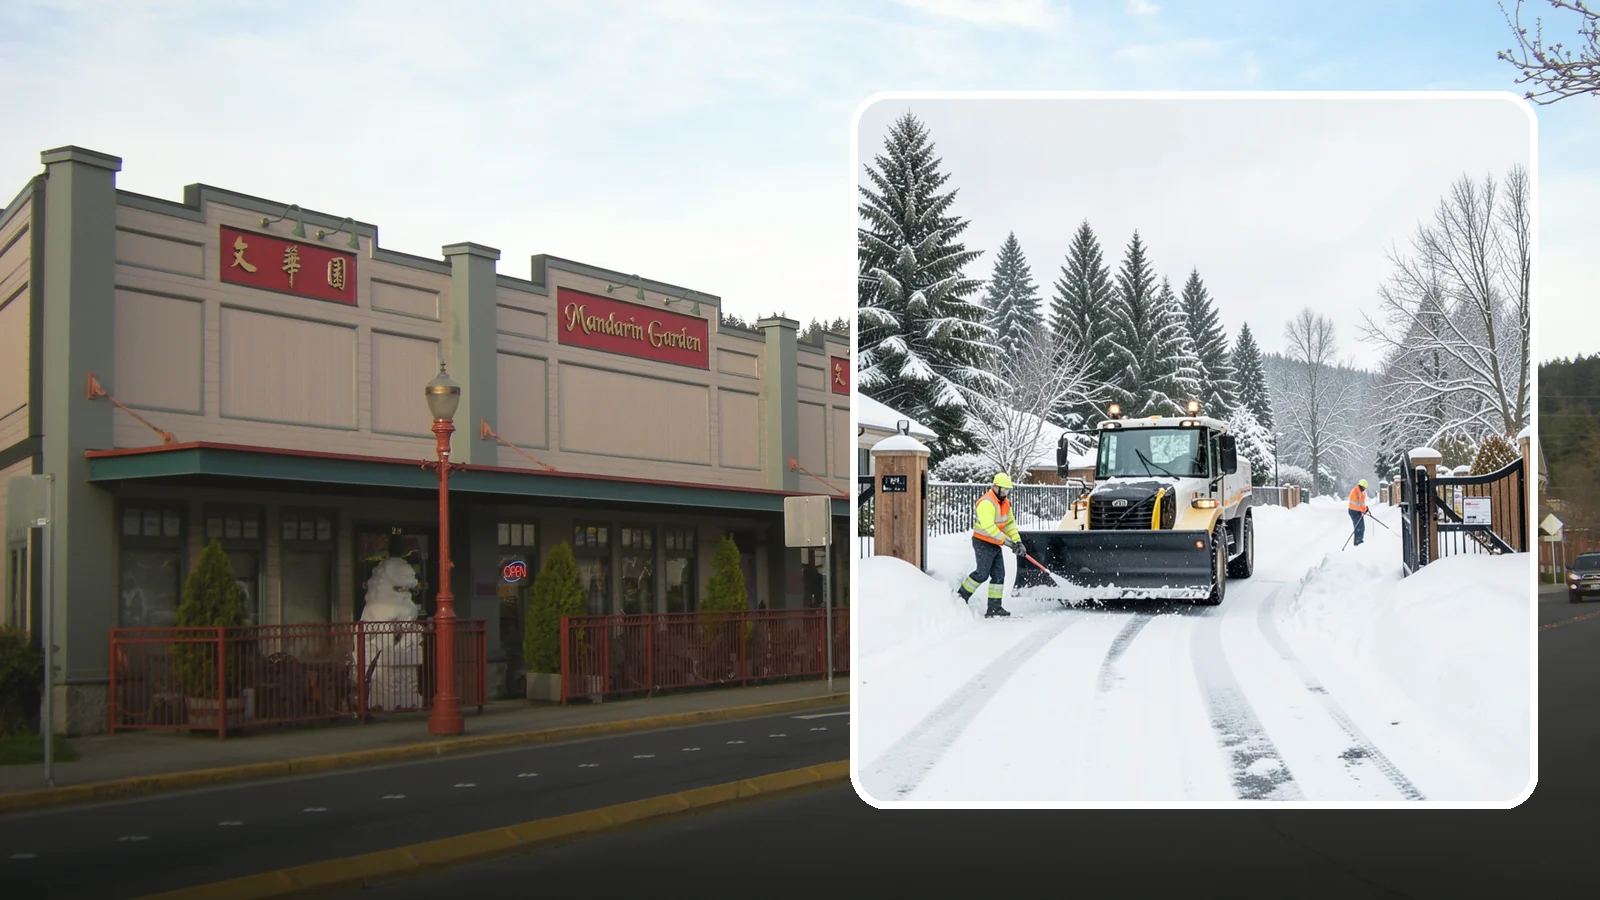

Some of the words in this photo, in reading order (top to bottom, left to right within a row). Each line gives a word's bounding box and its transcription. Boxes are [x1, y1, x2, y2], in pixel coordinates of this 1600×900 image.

[230, 235, 346, 291] 文華園
[564, 302, 644, 341] Mandarin
[647, 320, 702, 352] Garden
[503, 565, 527, 578] OPEN
